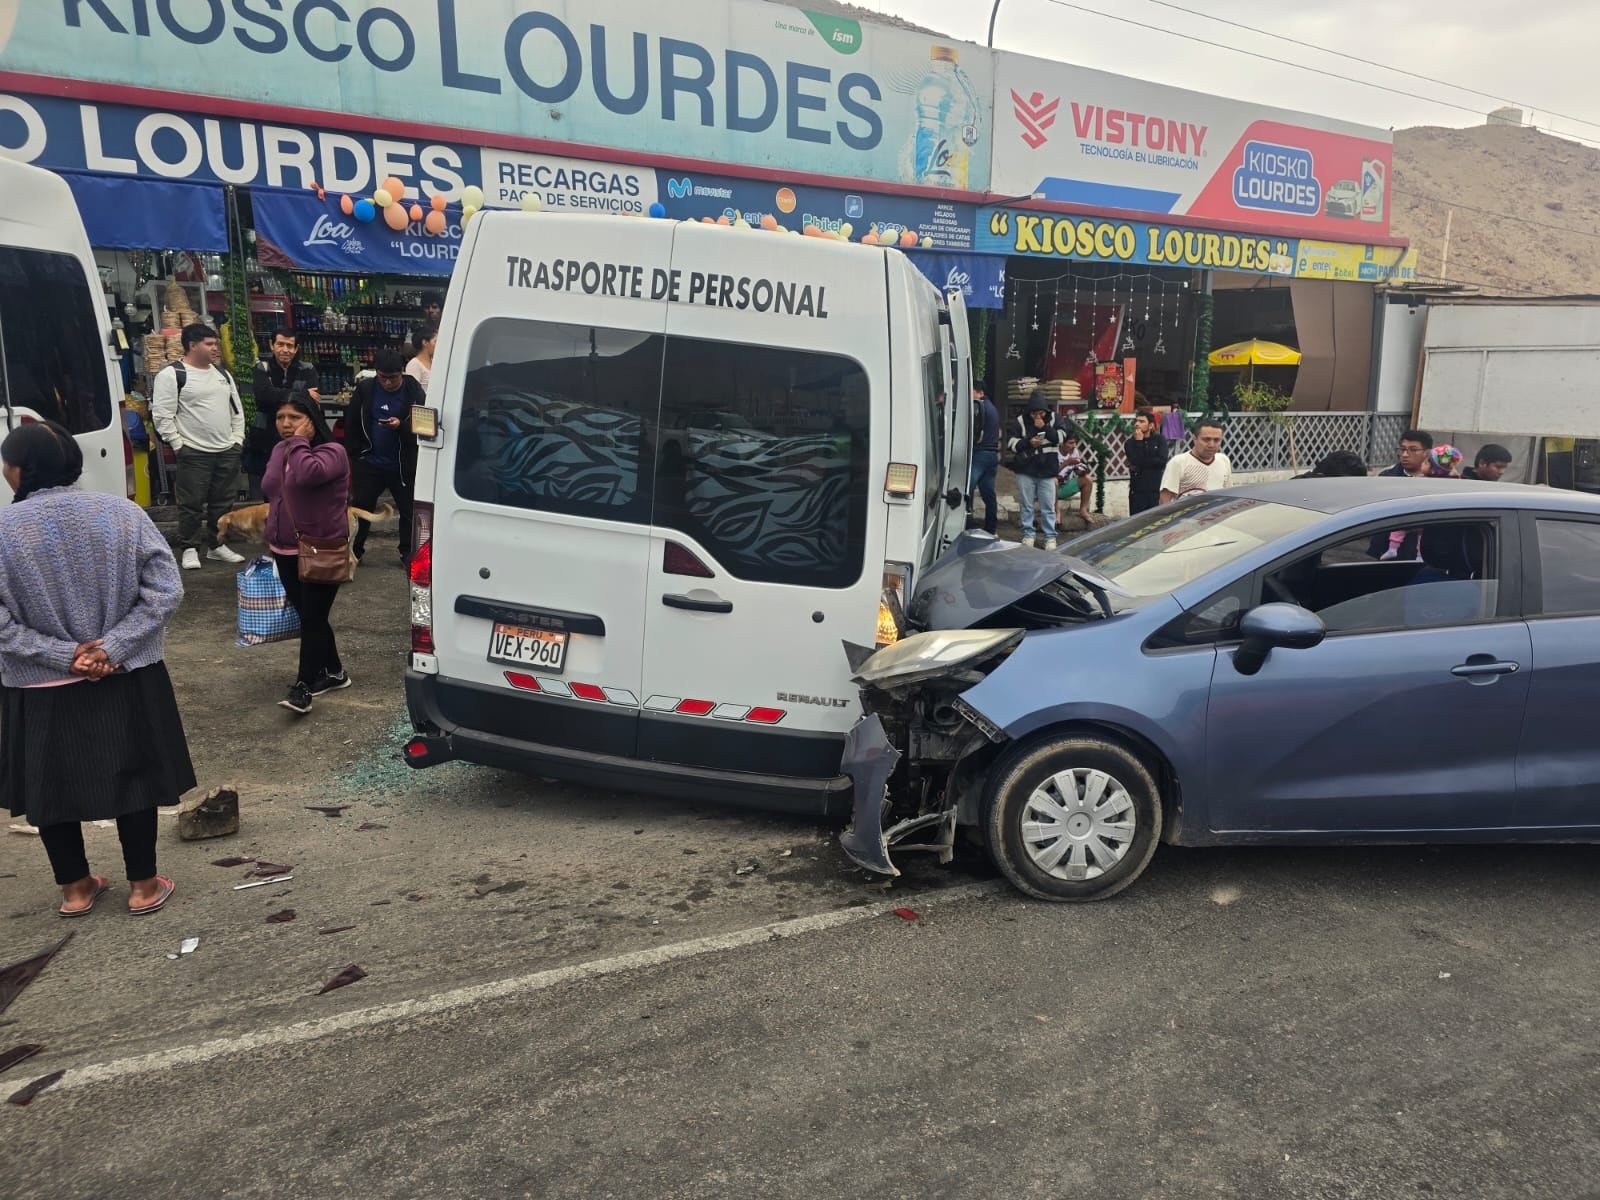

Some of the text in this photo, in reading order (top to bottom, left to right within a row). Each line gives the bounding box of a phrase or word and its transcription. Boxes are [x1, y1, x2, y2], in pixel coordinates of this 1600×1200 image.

[437, 0, 883, 151] LOURDES
[1070, 101, 1208, 157] VISTONY
[80, 105, 465, 204] LOURDES
[1080, 143, 1199, 171] TECNOLOGÍA EN LUBRICACIÓN
[1249, 151, 1308, 180] KIOSKO
[498, 161, 640, 196] RECARGAS
[1238, 176, 1316, 207] LOURDES
[546, 192, 566, 206] DE
[569, 194, 643, 213] SERVICIOS
[303, 214, 355, 246] Loa
[405, 222, 462, 239] KISC
[507, 255, 828, 319] TRASPORTE DE PERSONAL
[494, 633, 561, 665] VEX-960
[517, 628, 543, 639] PERU
[776, 692, 850, 708] RENAULT
